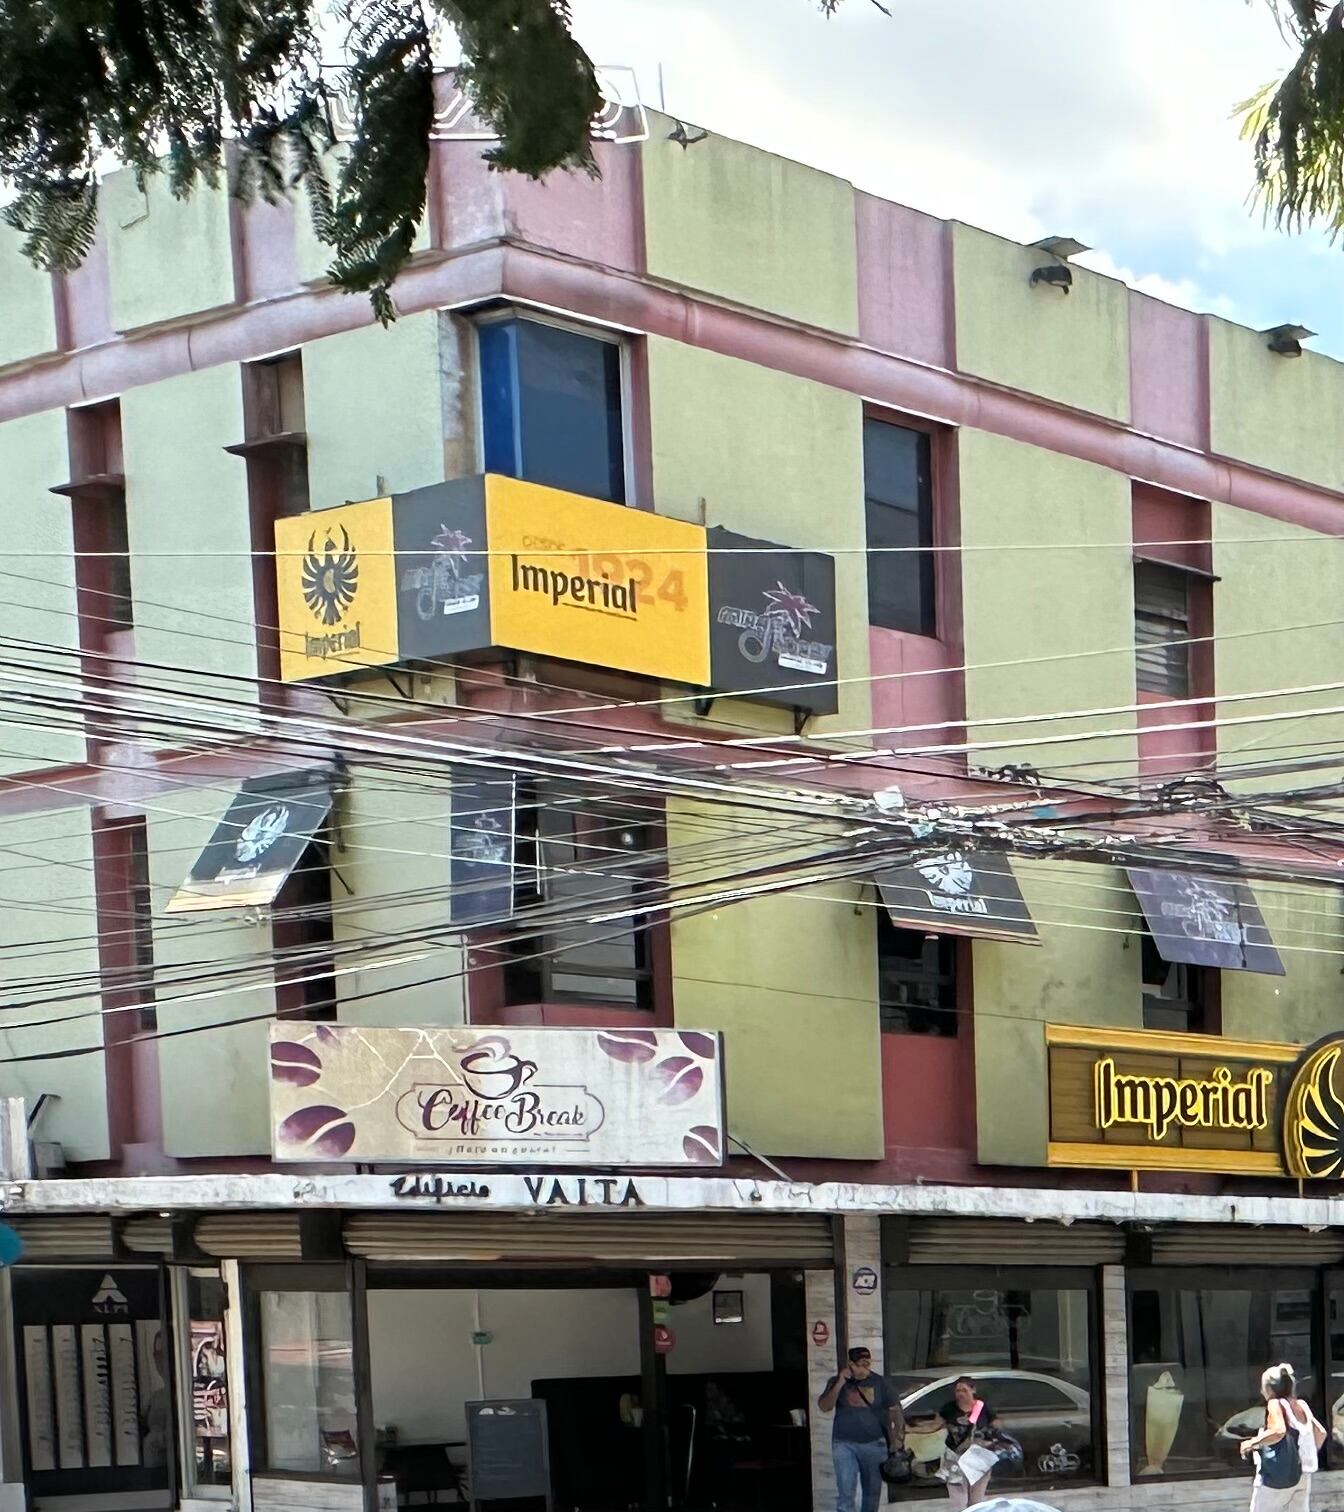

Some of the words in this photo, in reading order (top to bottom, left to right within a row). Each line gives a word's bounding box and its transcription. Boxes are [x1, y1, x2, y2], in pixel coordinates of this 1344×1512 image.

[511, 554, 637, 613] Imperial
[418, 1088, 505, 1136] Coffee
[505, 1091, 586, 1134] Break
[1095, 1057, 1273, 1140] Imperial
[523, 1176, 646, 1206] VAITA
